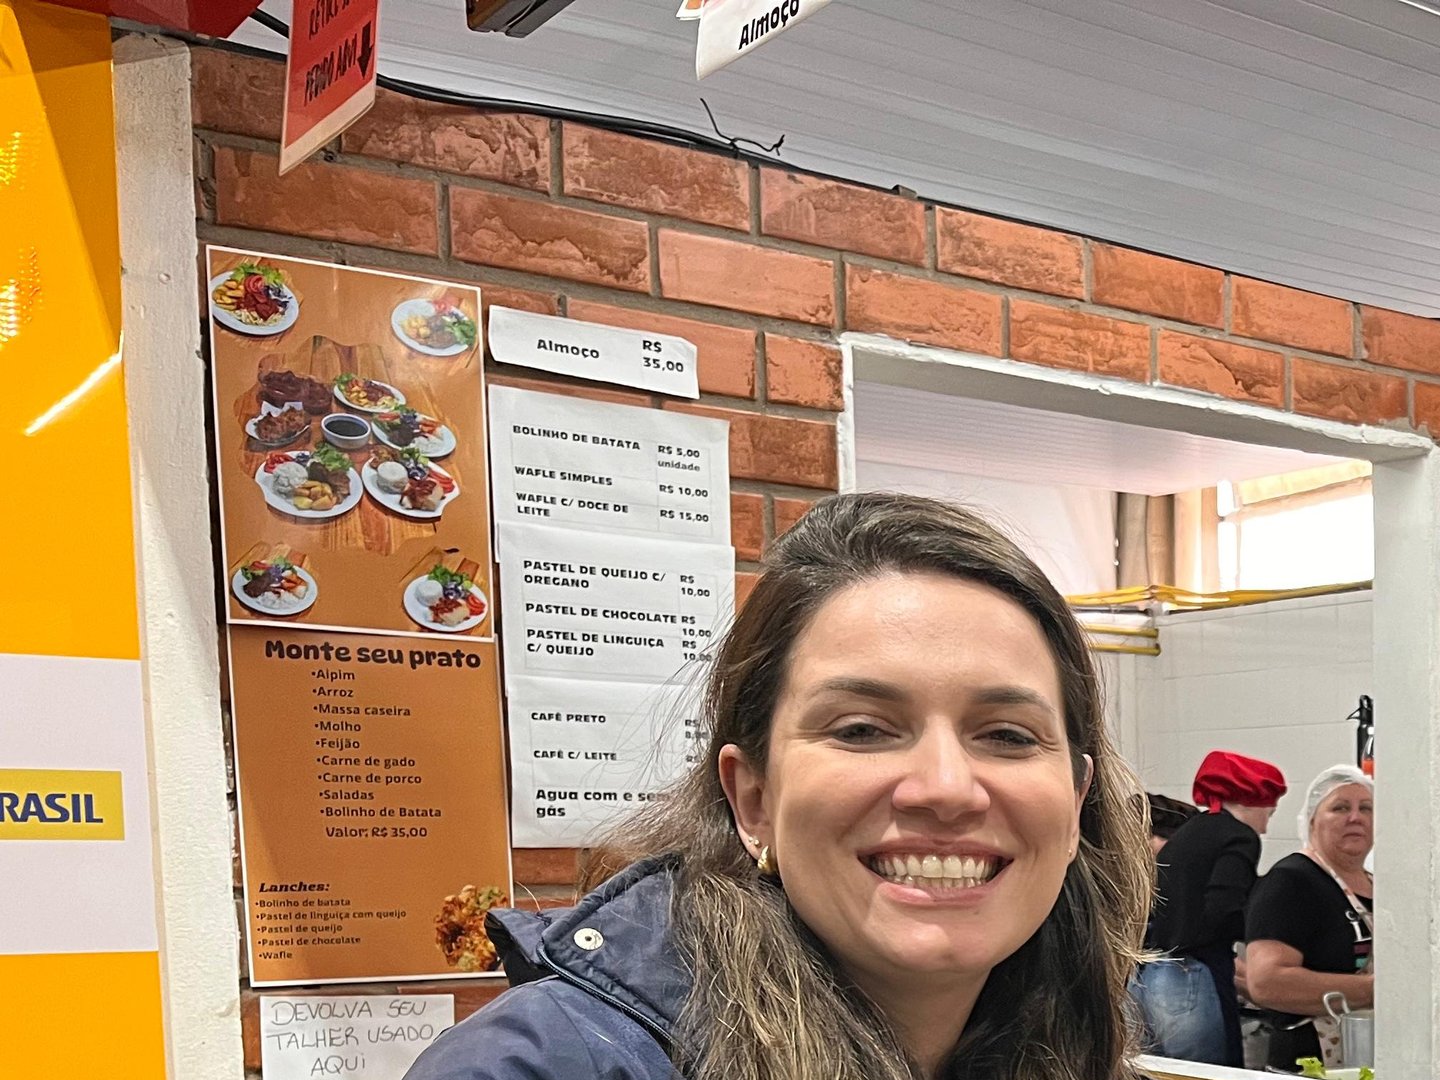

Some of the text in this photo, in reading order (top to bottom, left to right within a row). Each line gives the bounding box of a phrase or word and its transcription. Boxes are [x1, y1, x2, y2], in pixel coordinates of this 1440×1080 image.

[738, 0, 800, 50] Almoço
[536, 338, 600, 360] Almoço
[643, 357, 684, 373] 35,00
[512, 425, 641, 451] BOLINHO DE BATATA
[676, 448, 700, 459] 5,00
[657, 459, 701, 472] unidade
[514, 465, 613, 486] WAFLE SIMPLES
[677, 486, 709, 498] 10,00
[515, 492, 629, 514] WAFLE C/ DOCE DE
[517, 505, 551, 517] LEITE
[678, 511, 709, 523] 15,00
[523, 560, 667, 582] PASTEL DE QUEIJO C/
[524, 574, 590, 589] OREGANO
[680, 586, 710, 598] 10,00
[525, 603, 677, 624] PASTEL DE CHOCOLATE
[527, 628, 664, 649] PASTEL DE LINGUIÇA
[682, 627, 712, 638] 10,00
[265, 640, 481, 669] Monte seu prato
[527, 643, 594, 657] C/ QUEIJO
[316, 669, 356, 682] Aipim
[317, 687, 354, 698] Arroz
[319, 704, 412, 717] Massa caseira
[566, 714, 607, 723] PRETO
[320, 721, 362, 732] Molho
[320, 738, 360, 751] Feijão
[322, 755, 416, 770] Carne de gado
[568, 751, 581, 760] C/
[585, 752, 617, 761] LEITE
[323, 772, 422, 786] Carne de porco
[323, 789, 375, 801] Saladas
[536, 789, 578, 801] Agua
[584, 791, 618, 801] com
[623, 792, 632, 801] e
[325, 807, 442, 818] Bolinho de Batata
[536, 804, 566, 818] gás
[325, 826, 428, 839] Valor: R$ 35,00
[259, 881, 330, 893] Lanches:
[259, 898, 351, 908] Bolinho de batata
[260, 909, 407, 922] Pastel de linguiça com queijo
[261, 924, 343, 935] Pastel de queijo
[261, 936, 361, 947] Pastel de chocolate
[262, 951, 293, 960] Wafle
[271, 999, 427, 1026] DEVOLVA SEU
[266, 1024, 434, 1051] TALHER USADO
[310, 1053, 366, 1077] AQUI
